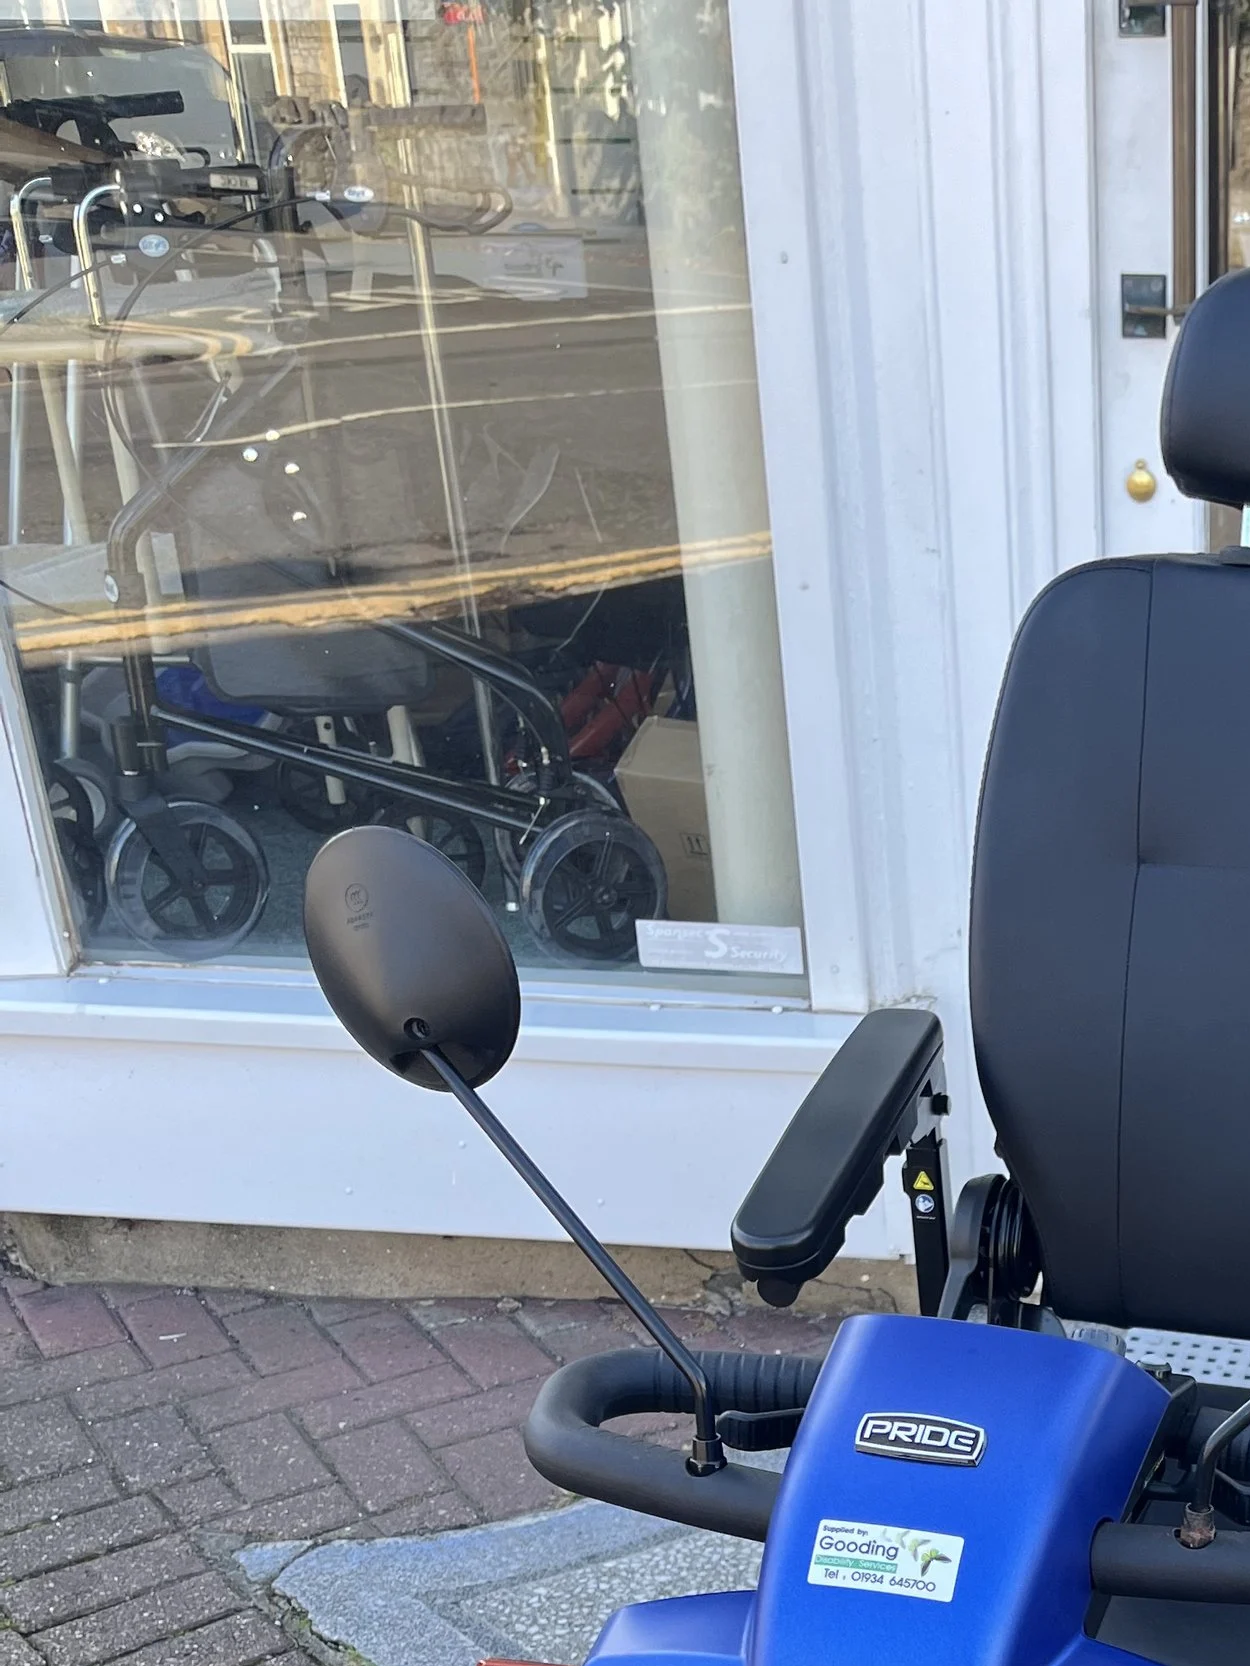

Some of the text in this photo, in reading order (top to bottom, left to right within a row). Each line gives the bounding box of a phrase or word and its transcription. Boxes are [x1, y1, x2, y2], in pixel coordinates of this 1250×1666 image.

[730, 947, 790, 964] Security
[863, 1419, 976, 1452] PRIDE
[823, 1525, 855, 1536] Supplied
[819, 1535, 899, 1561] Gooding
[858, 1560, 897, 1573] Services
[824, 1568, 839, 1579] Tel
[851, 1571, 884, 1584] 01934
[889, 1575, 936, 1592] 645700
